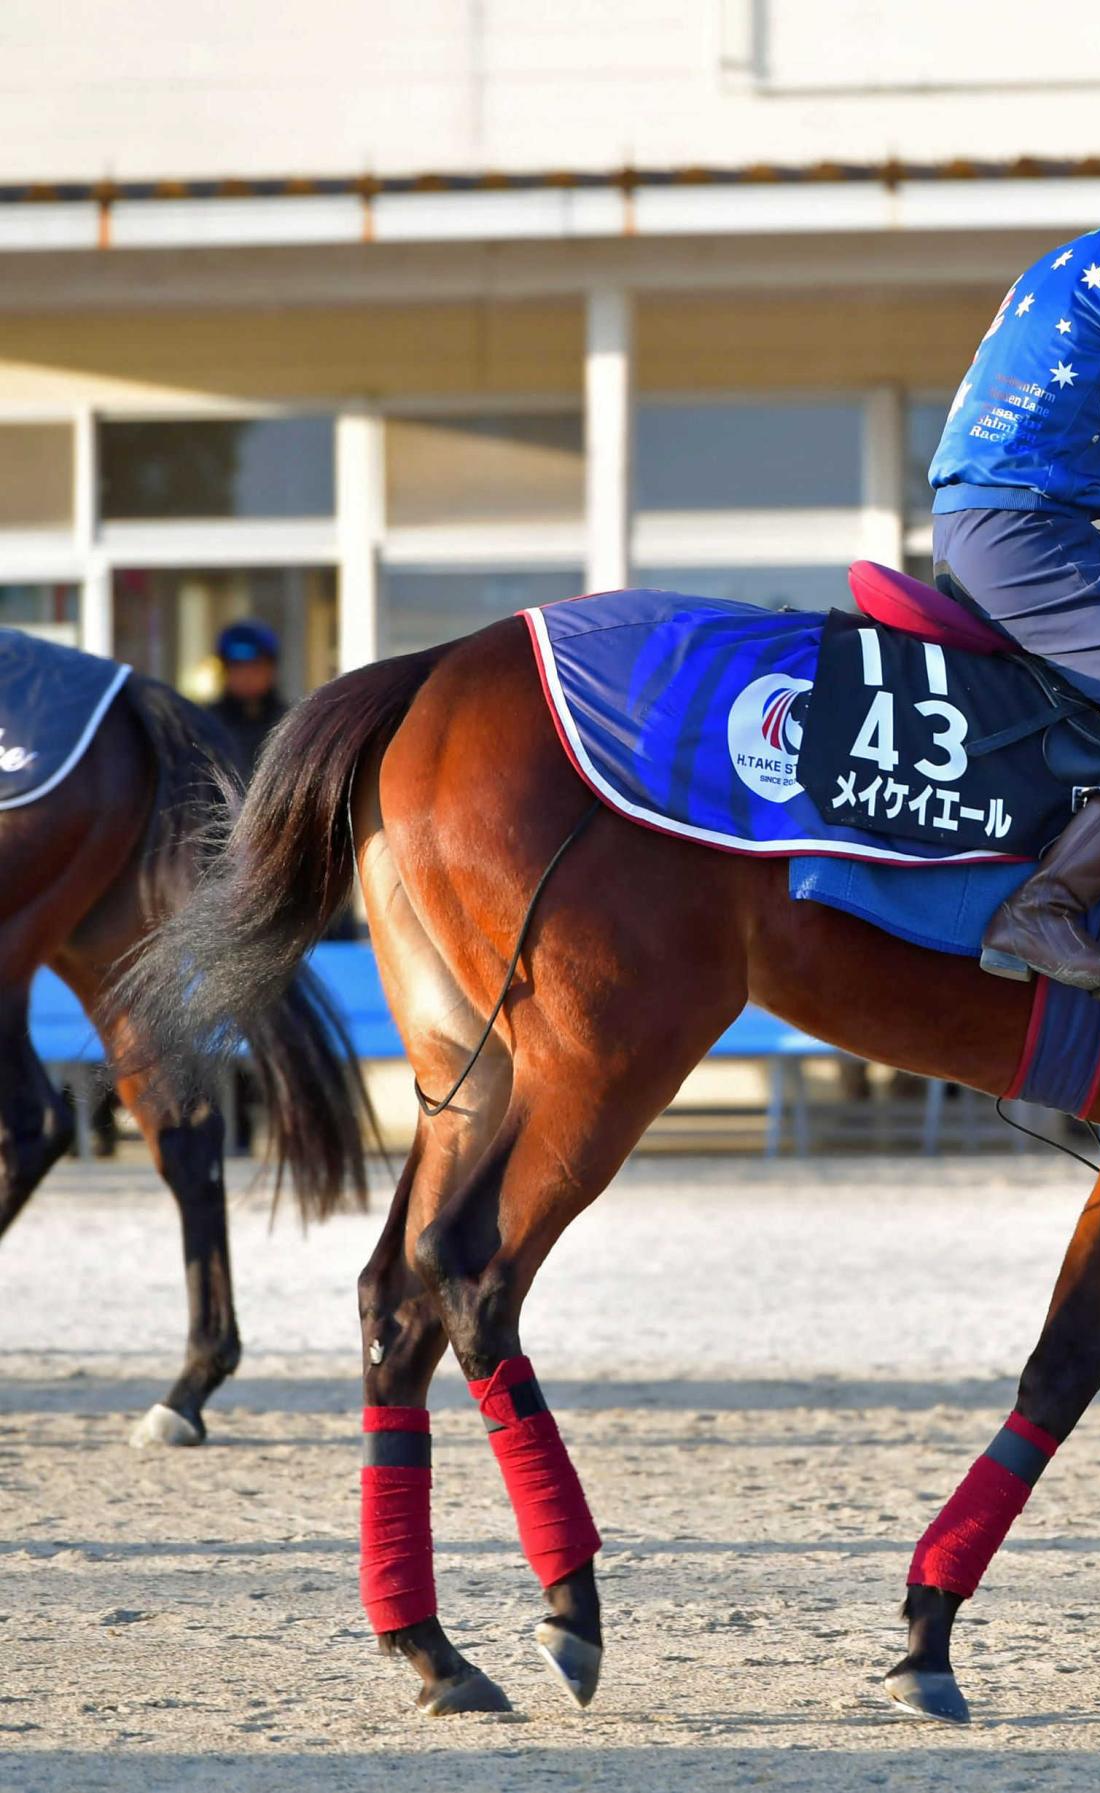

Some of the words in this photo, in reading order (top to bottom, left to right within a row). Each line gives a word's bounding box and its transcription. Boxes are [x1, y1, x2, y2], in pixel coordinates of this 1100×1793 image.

[850, 691, 968, 782] 43
[736, 753, 782, 773] H.TAKE
[759, 774, 782, 785] SINCE
[832, 770, 1012, 838] メイケイエール
